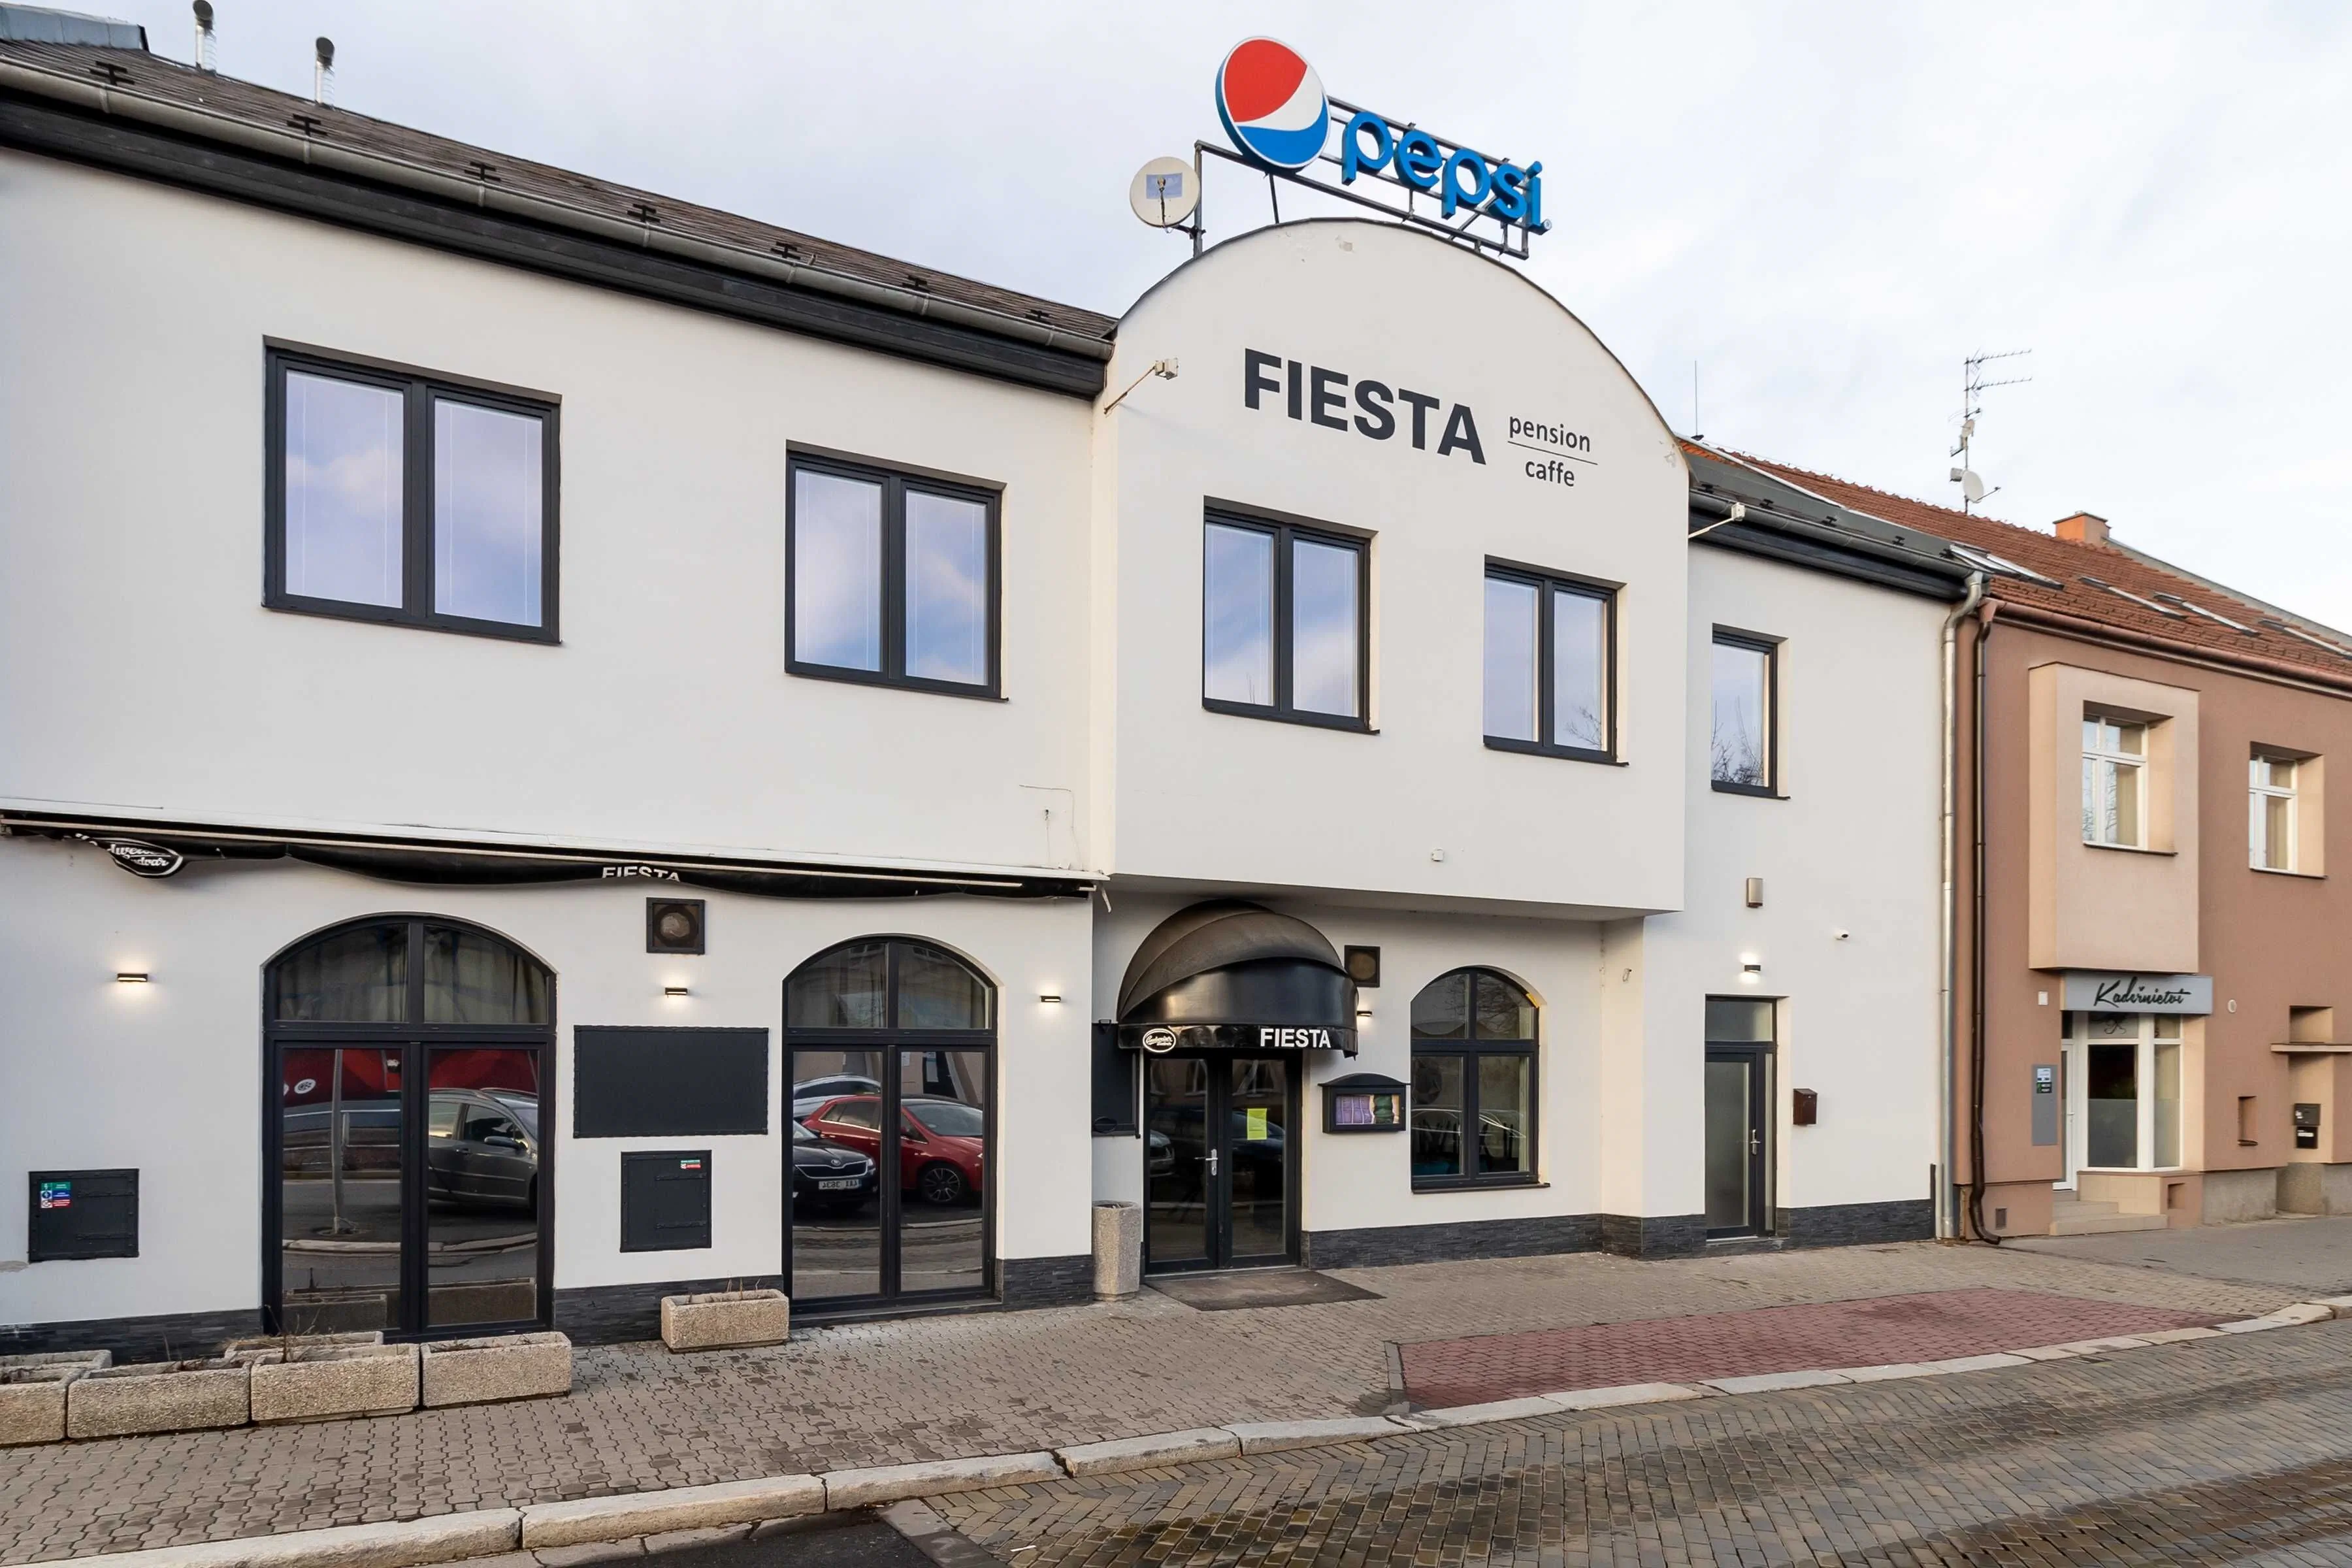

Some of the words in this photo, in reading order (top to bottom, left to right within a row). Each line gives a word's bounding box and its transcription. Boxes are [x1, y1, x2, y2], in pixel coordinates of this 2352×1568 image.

[1342, 111, 1543, 230] pepsi
[1245, 348, 1486, 465] FIESTA
[1510, 416, 1590, 452] pension
[1525, 459, 1575, 487] caffe
[1260, 1028, 1331, 1048] FIESTA
